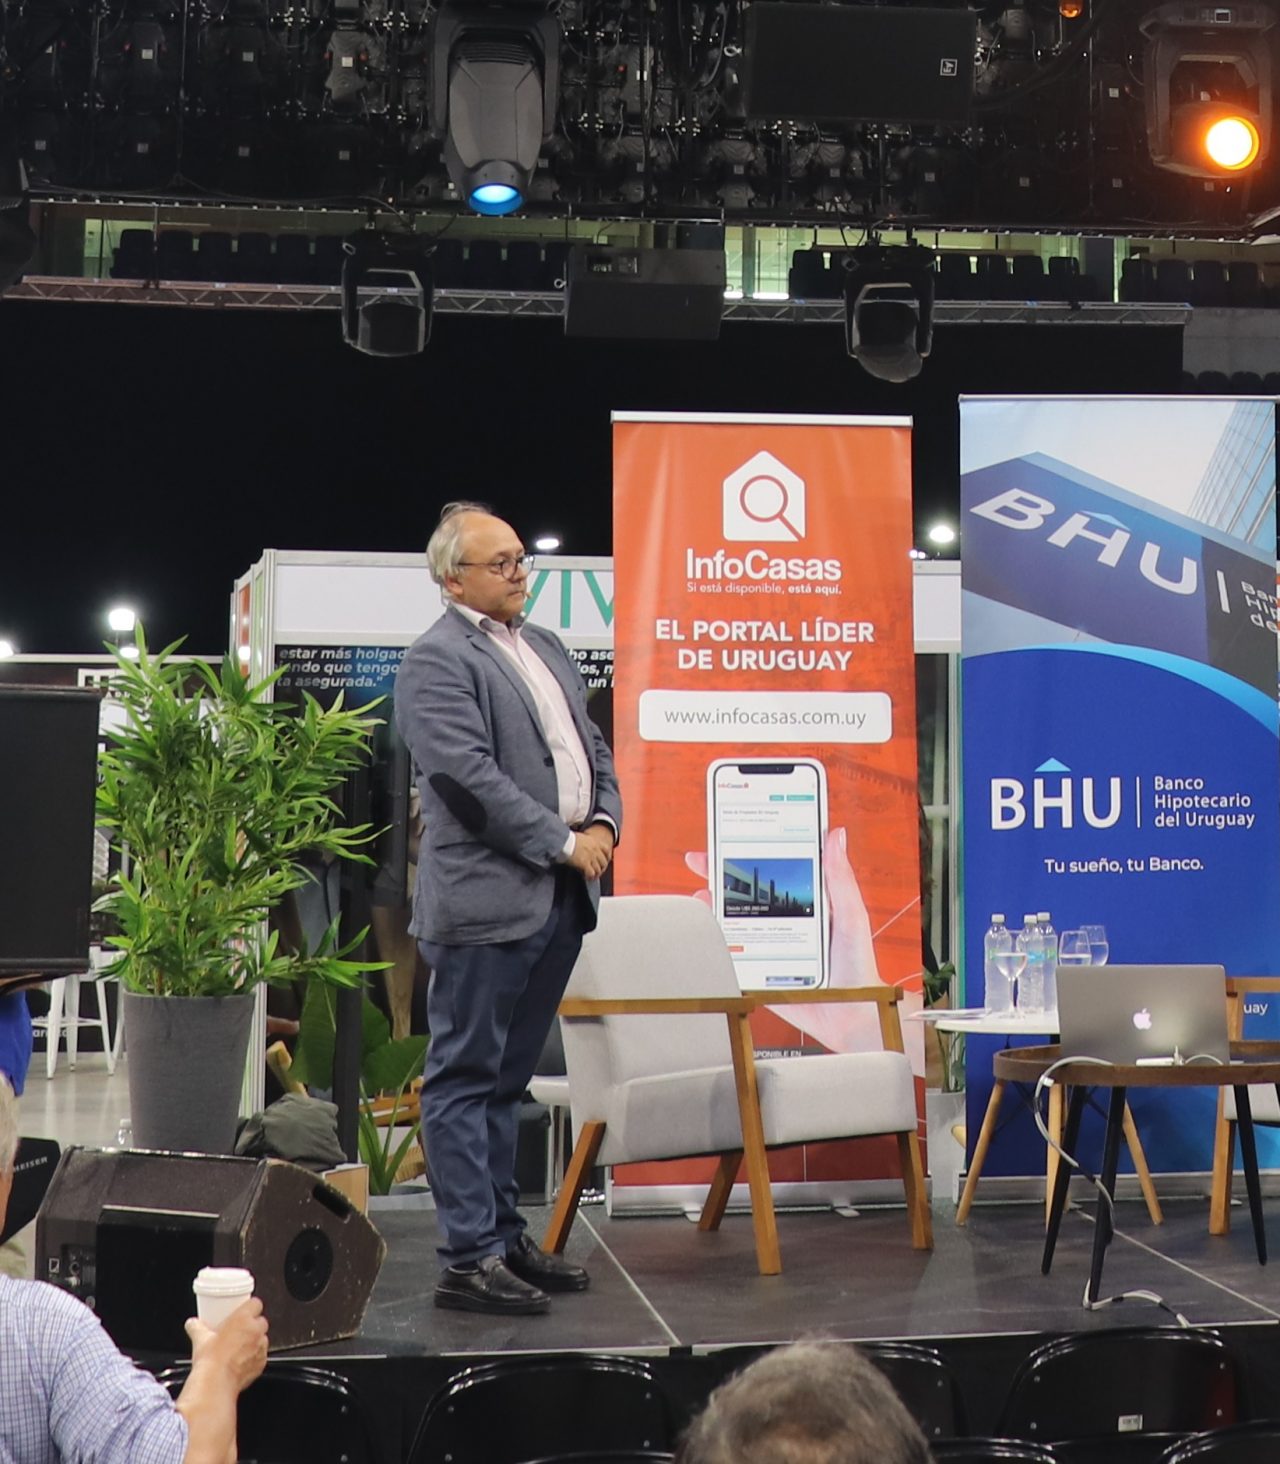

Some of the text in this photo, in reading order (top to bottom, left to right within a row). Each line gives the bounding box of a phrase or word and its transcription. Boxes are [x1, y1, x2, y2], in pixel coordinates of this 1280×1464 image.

[968, 488, 1198, 596] BHU
[686, 547, 842, 581] InfoCasas
[687, 581, 842, 596] Si está disponible, está aquí.
[1241, 580, 1278, 604] Ban
[655, 616, 874, 643] EL PORTAL LÍDER
[280, 648, 317, 660] estar
[320, 647, 352, 660] más
[356, 647, 408, 662] holgad
[677, 649, 853, 671] DE URUGUAY
[323, 663, 353, 677] que
[356, 663, 400, 677] tengo
[664, 707, 867, 729] www.infocasas.com.uy
[1154, 775, 1204, 791] Banco
[990, 776, 1122, 831] BHU
[1154, 793, 1251, 812] Hipotecario
[1154, 812, 1256, 830] del Uruguay
[1044, 857, 1204, 876] Tu sueño, tu Banco.
[1243, 1002, 1268, 1016] uay
